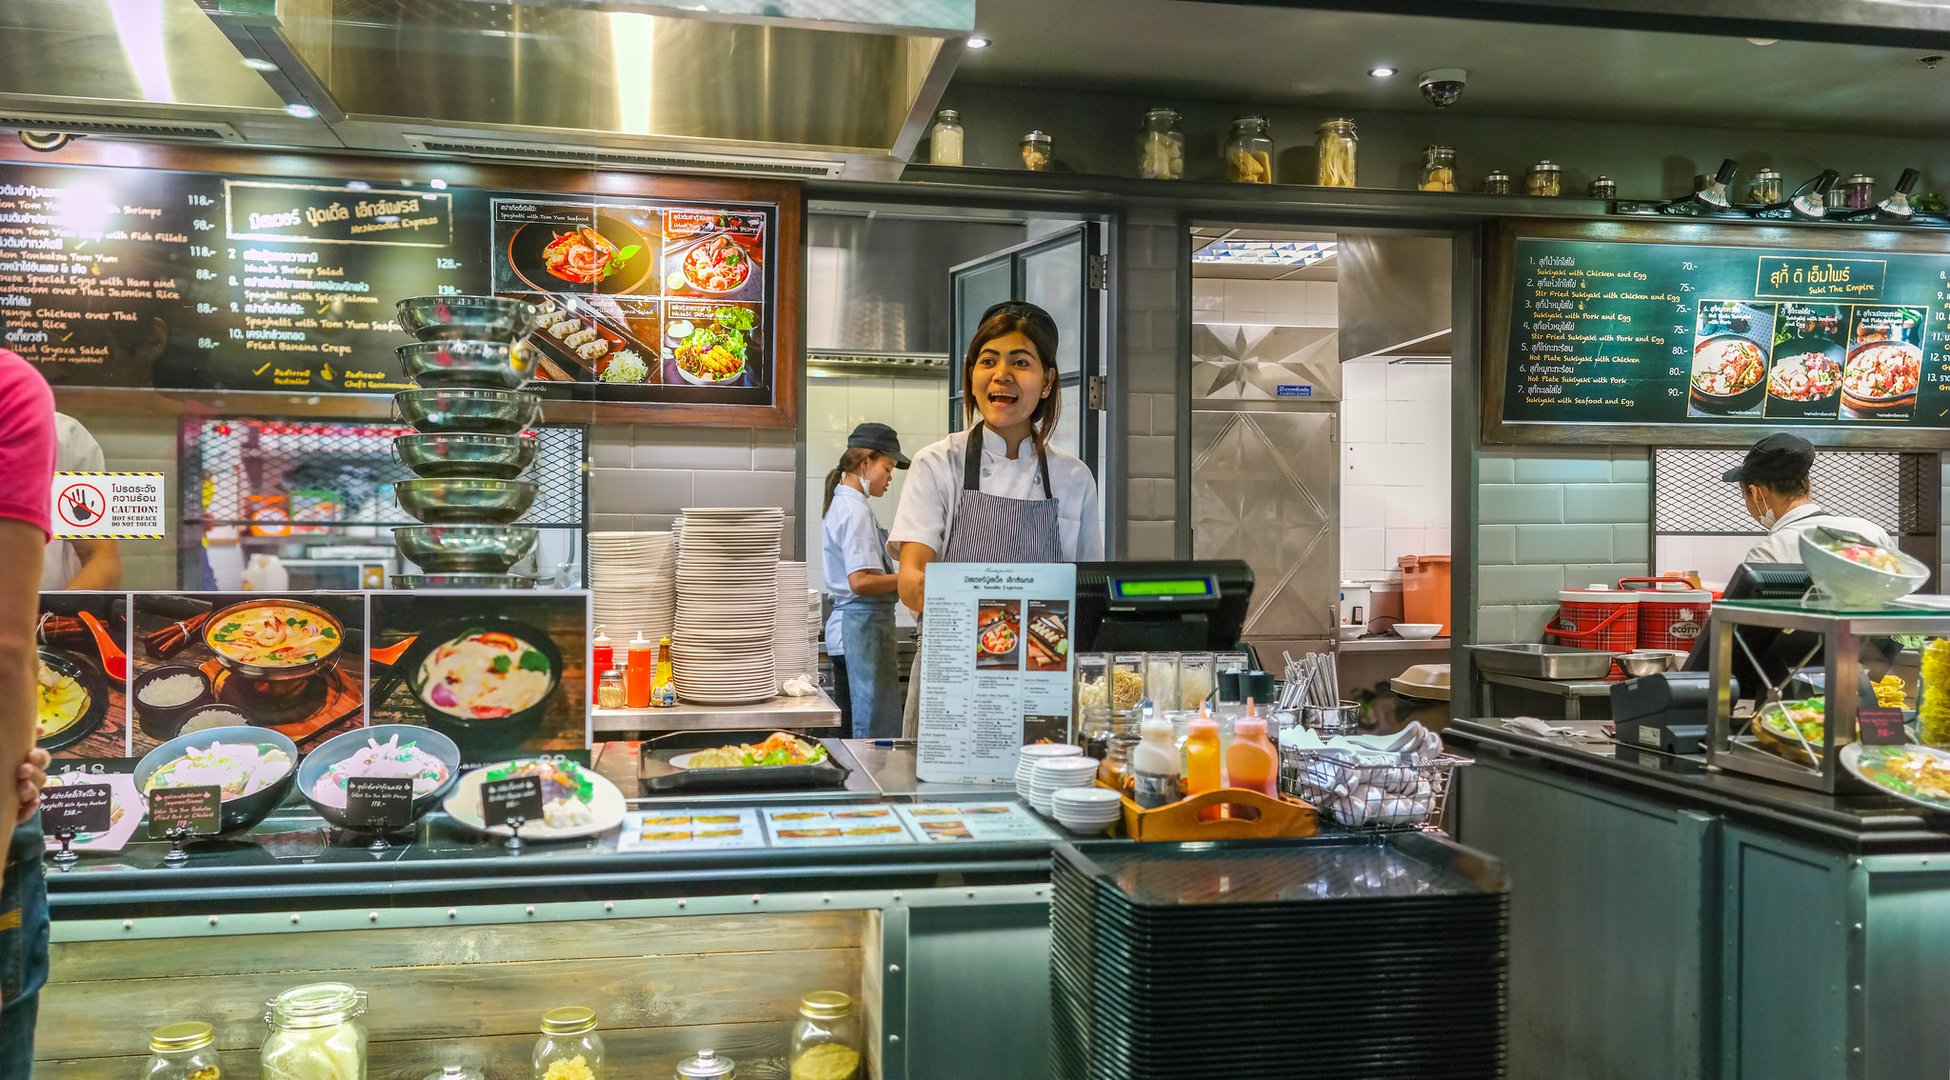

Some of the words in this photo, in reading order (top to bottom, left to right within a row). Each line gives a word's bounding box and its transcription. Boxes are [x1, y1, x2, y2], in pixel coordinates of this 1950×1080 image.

[18, 201, 41, 210] Tom
[188, 194, 215, 206] 118.-
[193, 219, 216, 231] 98.-
[26, 227, 50, 236] Tom
[190, 245, 217, 257] 118.-
[69, 252, 93, 262] Tom
[436, 258, 462, 270] 128.-
[1682, 261, 1698, 270] 70.-
[196, 269, 218, 280] 88.-
[280, 264, 315, 279] Shrimp
[316, 266, 344, 276] Salad
[1537, 268, 1566, 278] Sukiyaki
[1633, 272, 1647, 280] Egg
[1770, 263, 1789, 288] สุกี้
[1807, 263, 1850, 283] เอ็มไพร์
[27, 274, 66, 287] Special
[69, 276, 97, 288] Eggs
[99, 276, 124, 286] with
[126, 278, 151, 287] Ham
[153, 278, 176, 288] and
[1680, 283, 1695, 291] 75.-
[1808, 286, 1827, 295] Suki
[1829, 285, 1843, 293] The
[1846, 283, 1874, 295] Empire
[52, 288, 77, 296] over
[80, 286, 106, 297] Thai
[108, 288, 153, 299] Jasmine
[155, 290, 181, 300] Rice
[244, 289, 289, 302] Spaghetti
[290, 291, 313, 301] with
[1571, 291, 1601, 301] Sukiyaki
[1667, 294, 1680, 302] Egg
[197, 303, 219, 314] 88.-
[1676, 304, 1691, 313] 75.-
[36, 309, 82, 319] Chicken
[85, 312, 111, 320] over
[112, 311, 138, 321] Thai
[1533, 311, 1563, 321] Sukiyaki
[1617, 314, 1631, 322] Egg
[43, 320, 68, 330] Rice
[245, 316, 292, 329] Spaghetti
[294, 318, 318, 327] with
[320, 319, 343, 328] Tom
[345, 320, 369, 329] Yum
[229, 328, 244, 339] 10.
[1674, 325, 1689, 334] 75.-
[198, 338, 220, 349] 88.-
[1567, 334, 1597, 344] Sukiyaki
[1651, 336, 1664, 344] Egg
[79, 345, 109, 356] Salad
[246, 341, 276, 350] Fried
[279, 342, 318, 352] Banana
[321, 343, 352, 357] Crepe
[1672, 346, 1688, 355] 80.-
[1563, 355, 1592, 364] Sukiyaki
[1669, 367, 1685, 375] 80.-
[1561, 377, 1591, 386] Sukiyaki
[1668, 388, 1683, 396] 90.-
[1526, 396, 1555, 406] Sukiyaki
[1574, 396, 1602, 405] Seafood
[1621, 398, 1634, 407] Egg
[112, 483, 156, 493] โปรดระวัง
[112, 493, 156, 502] ความร้อน
[1671, 626, 1700, 634] SCOTTY
